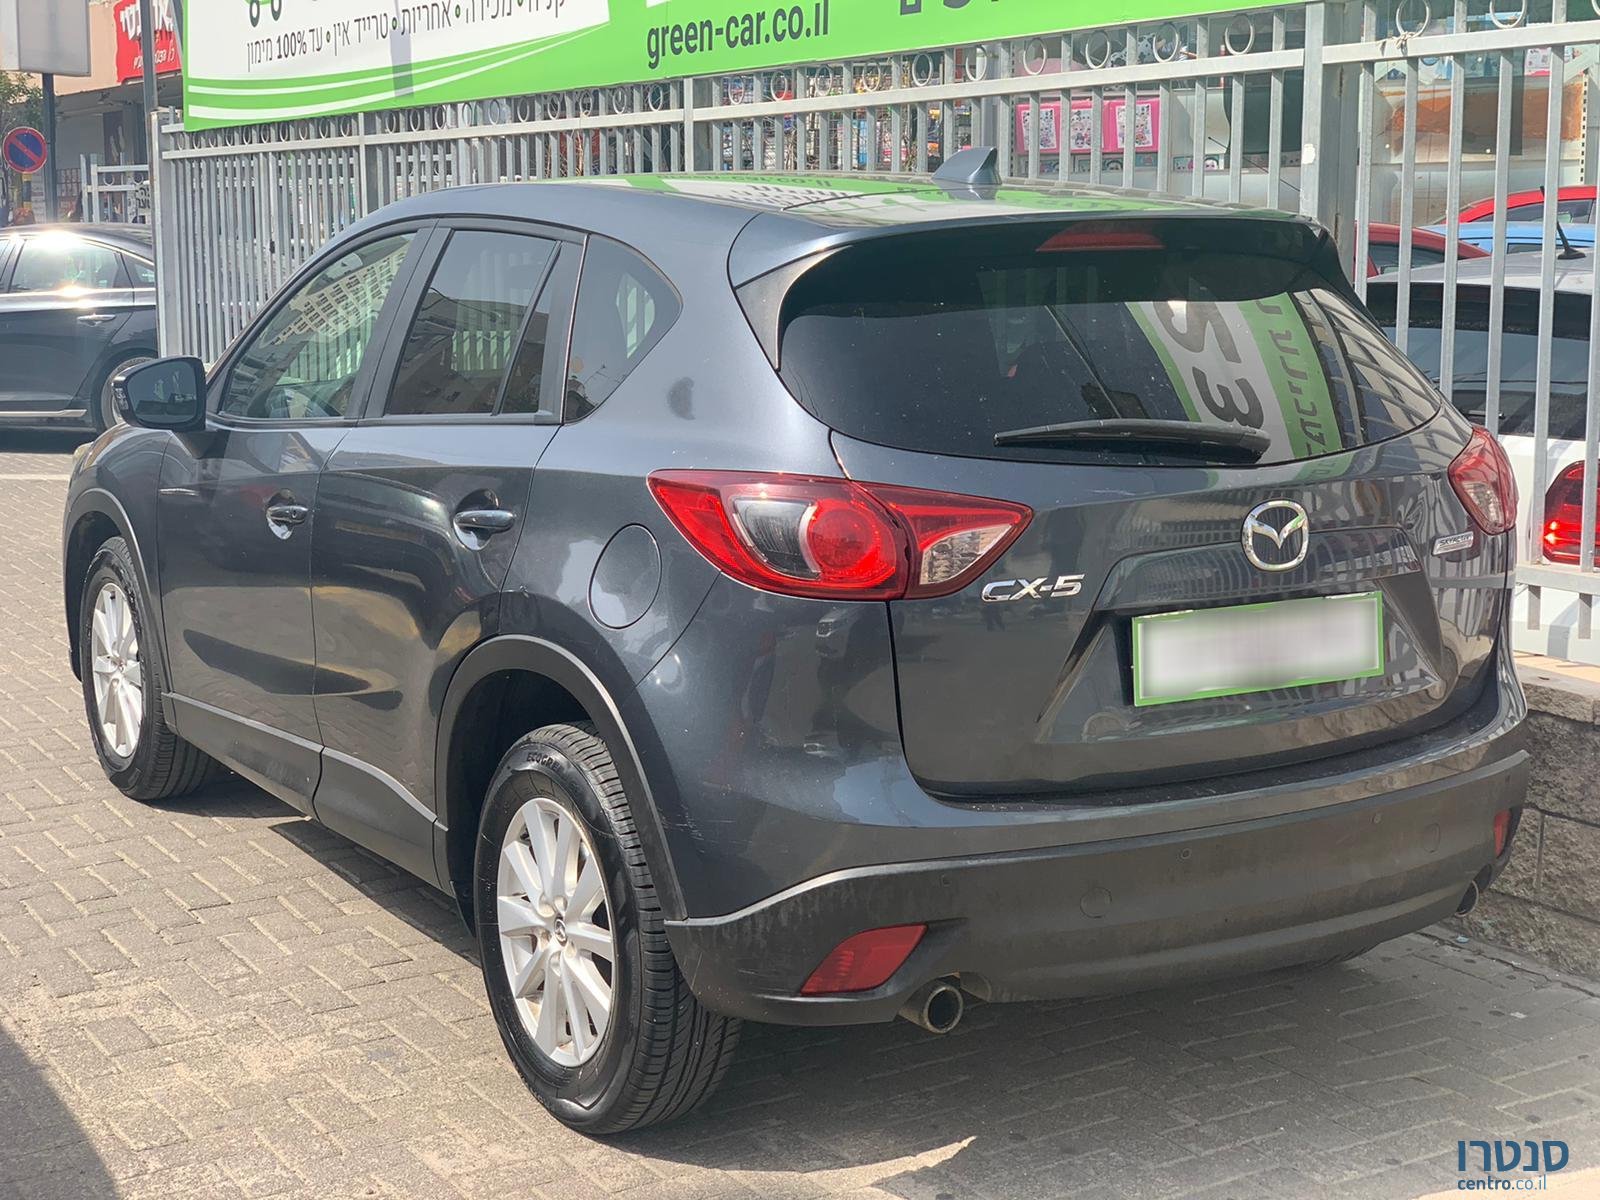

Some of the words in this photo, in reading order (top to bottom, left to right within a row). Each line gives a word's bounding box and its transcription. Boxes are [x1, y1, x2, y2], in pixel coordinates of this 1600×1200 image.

[354, 13, 389, 43] טרייד
[401, 1, 452, 36] אחריות
[647, 0, 830, 69] green-car.co.il
[276, 30, 308, 60] 100%
[308, 26, 323, 53] עד
[333, 20, 351, 57] אין
[247, 37, 273, 73] מימון
[982, 574, 1085, 602] CX-5
